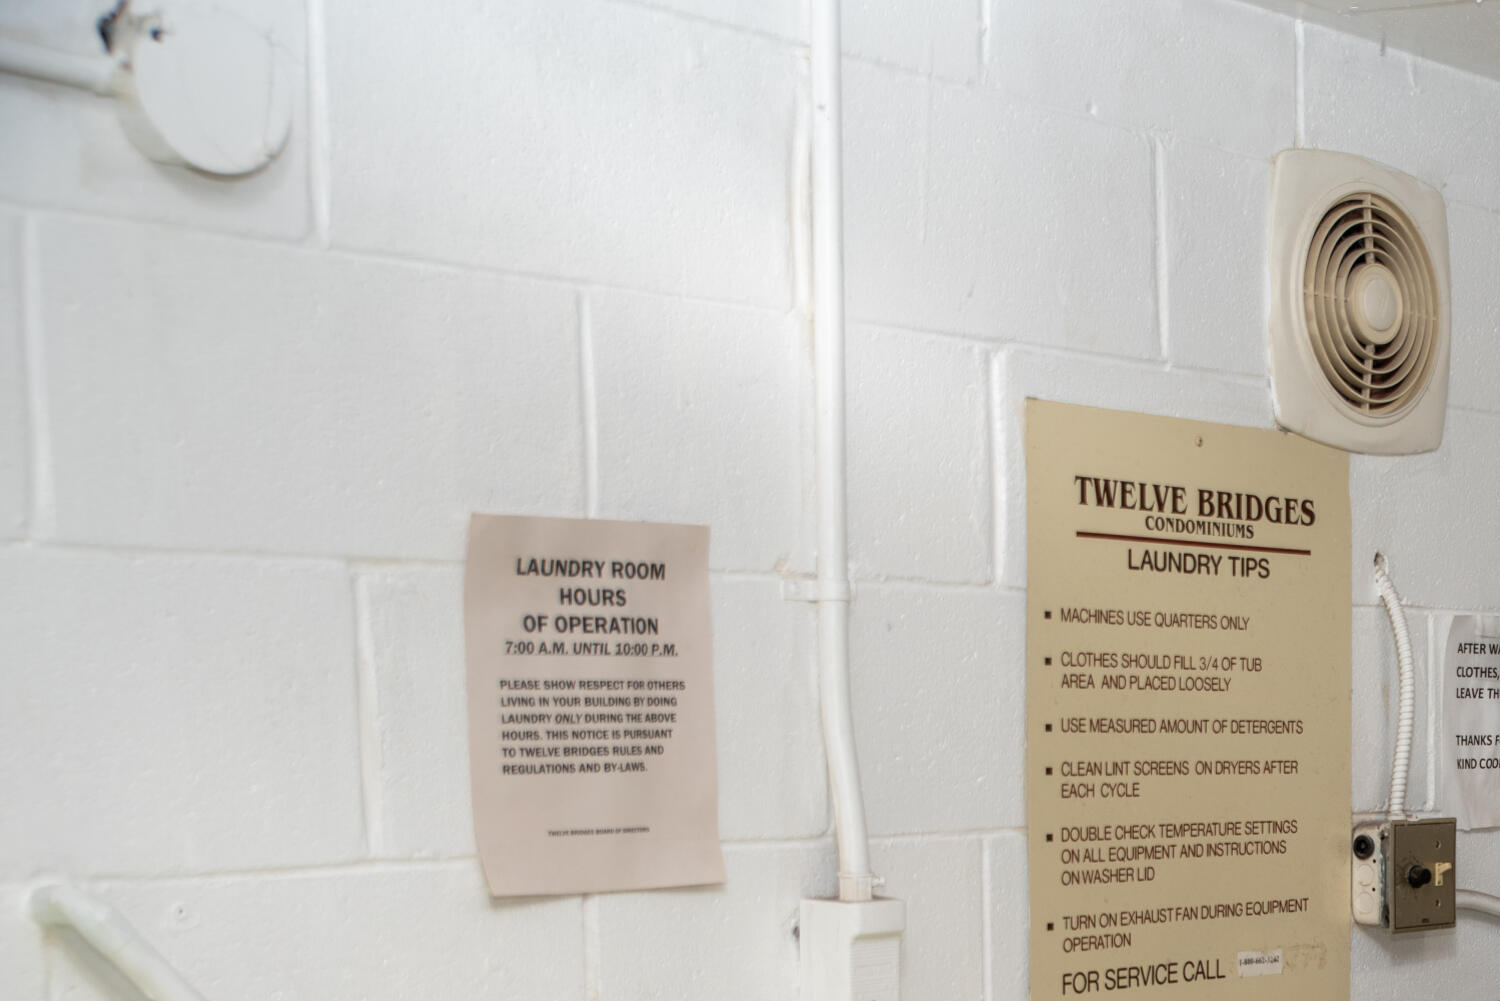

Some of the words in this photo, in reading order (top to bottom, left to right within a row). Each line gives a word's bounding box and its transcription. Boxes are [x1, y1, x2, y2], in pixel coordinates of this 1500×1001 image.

[1073, 475, 1188, 515] TWELVE
[1197, 488, 1316, 527] BRIDGES
[1144, 515, 1255, 539] CONDOMINIUMS
[515, 557, 606, 578] LAUNDRY
[610, 561, 666, 581] ROOM
[1127, 548, 1223, 576] LAUNDRY
[1227, 555, 1271, 579] TIPS
[559, 587, 627, 607] HOURS
[522, 614, 549, 633] OF
[554, 615, 659, 636] OPERATION
[1060, 607, 1124, 626] MACHINES
[1127, 611, 1152, 627] USE
[1154, 612, 1218, 630] QUARTERS
[1220, 615, 1250, 631] ONLY
[504, 641, 535, 655] 7:00
[538, 641, 569, 656] A.M.
[572, 642, 612, 656] UNTIL
[614, 642, 649, 657] 10:00
[650, 643, 679, 657] P.M.
[1457, 643, 1487, 655] AFTER
[1060, 651, 1118, 669] CLOTHES
[1121, 654, 1171, 670] SHOULD
[1174, 655, 1196, 671] FILL
[1199, 655, 1219, 671] 3/4
[1221, 656, 1238, 671] OF
[1239, 657, 1263, 672] TUB
[1456, 666, 1500, 680] CLOTHES,
[499, 679, 541, 691] PLEASE
[543, 680, 576, 691] SHOW
[578, 680, 625, 691] RESPECT
[626, 680, 646, 691] FOR
[647, 680, 686, 691] OTHERS
[1060, 674, 1095, 690] AREA
[1101, 675, 1127, 690] AND
[1129, 676, 1176, 691] PLACED
[1178, 676, 1232, 692] LOOSELY
[500, 696, 536, 708] LIVING
[539, 696, 549, 708] IN
[552, 696, 582, 708] YOUR
[584, 696, 631, 708] BUILDING
[633, 696, 645, 707] BY
[646, 696, 678, 707] DOING
[1456, 688, 1484, 699] LEAVE
[501, 713, 552, 725] LAUNDRY
[555, 713, 583, 725] ONLY
[584, 713, 624, 724] DURING
[625, 713, 643, 724] THE
[644, 712, 677, 724] ABOVE
[1060, 718, 1087, 734] USE
[1089, 718, 1157, 734] MEASURED
[1159, 719, 1210, 734] AMOUNT
[1212, 719, 1228, 735] OF
[1230, 719, 1304, 735] DETERGENTS
[501, 730, 542, 742] HOURS.
[545, 729, 569, 741] THIS
[571, 729, 609, 740] NOTICE
[611, 729, 621, 740] IS
[623, 728, 673, 740] PURSUANT
[1456, 735, 1493, 746] THANKS
[501, 747, 517, 758] TO
[519, 746, 561, 758] TWELVE
[563, 746, 610, 757] BRIDGES
[612, 745, 643, 756] RULES
[644, 745, 665, 756] AND
[502, 763, 576, 775] REGULATIONS
[578, 763, 601, 774] AND
[603, 762, 648, 774] BY-LAWS.
[1060, 761, 1103, 777] CLEAN
[1104, 761, 1131, 777] LINT
[1133, 760, 1190, 777] SCREENS
[1195, 760, 1214, 776] ON
[1215, 760, 1262, 776] DRYERS
[1263, 760, 1299, 775] AFTER
[1456, 758, 1477, 770] KIND
[1060, 783, 1095, 799] EACH
[1100, 782, 1140, 798] CYCLE
[1060, 825, 1112, 843] DOUBLE
[1114, 824, 1156, 840] CHECK
[1159, 821, 1241, 839] TEMPERATURE
[1244, 820, 1298, 836] SETTINGS
[1061, 848, 1081, 865] ON
[1082, 847, 1105, 863] ALL
[1108, 844, 1177, 862] EQUIPMENT
[1179, 843, 1204, 859] AND
[1205, 840, 1287, 857] INSTRUCTIONS
[1061, 870, 1081, 886] ON
[1082, 868, 1135, 885] WASHER
[1137, 866, 1155, 882] LID
[1063, 913, 1097, 932] TURN
[1099, 912, 1118, 928] ON
[1120, 908, 1174, 927] EXHAUST
[1175, 906, 1198, 922] FAN
[1201, 903, 1244, 920] DURING
[1245, 897, 1309, 917] EQUIPMENT
[1063, 933, 1132, 954] OPERATION
[1062, 971, 1100, 996] FOR
[1104, 962, 1179, 991] SERVICE
[1182, 958, 1226, 983] CALL
